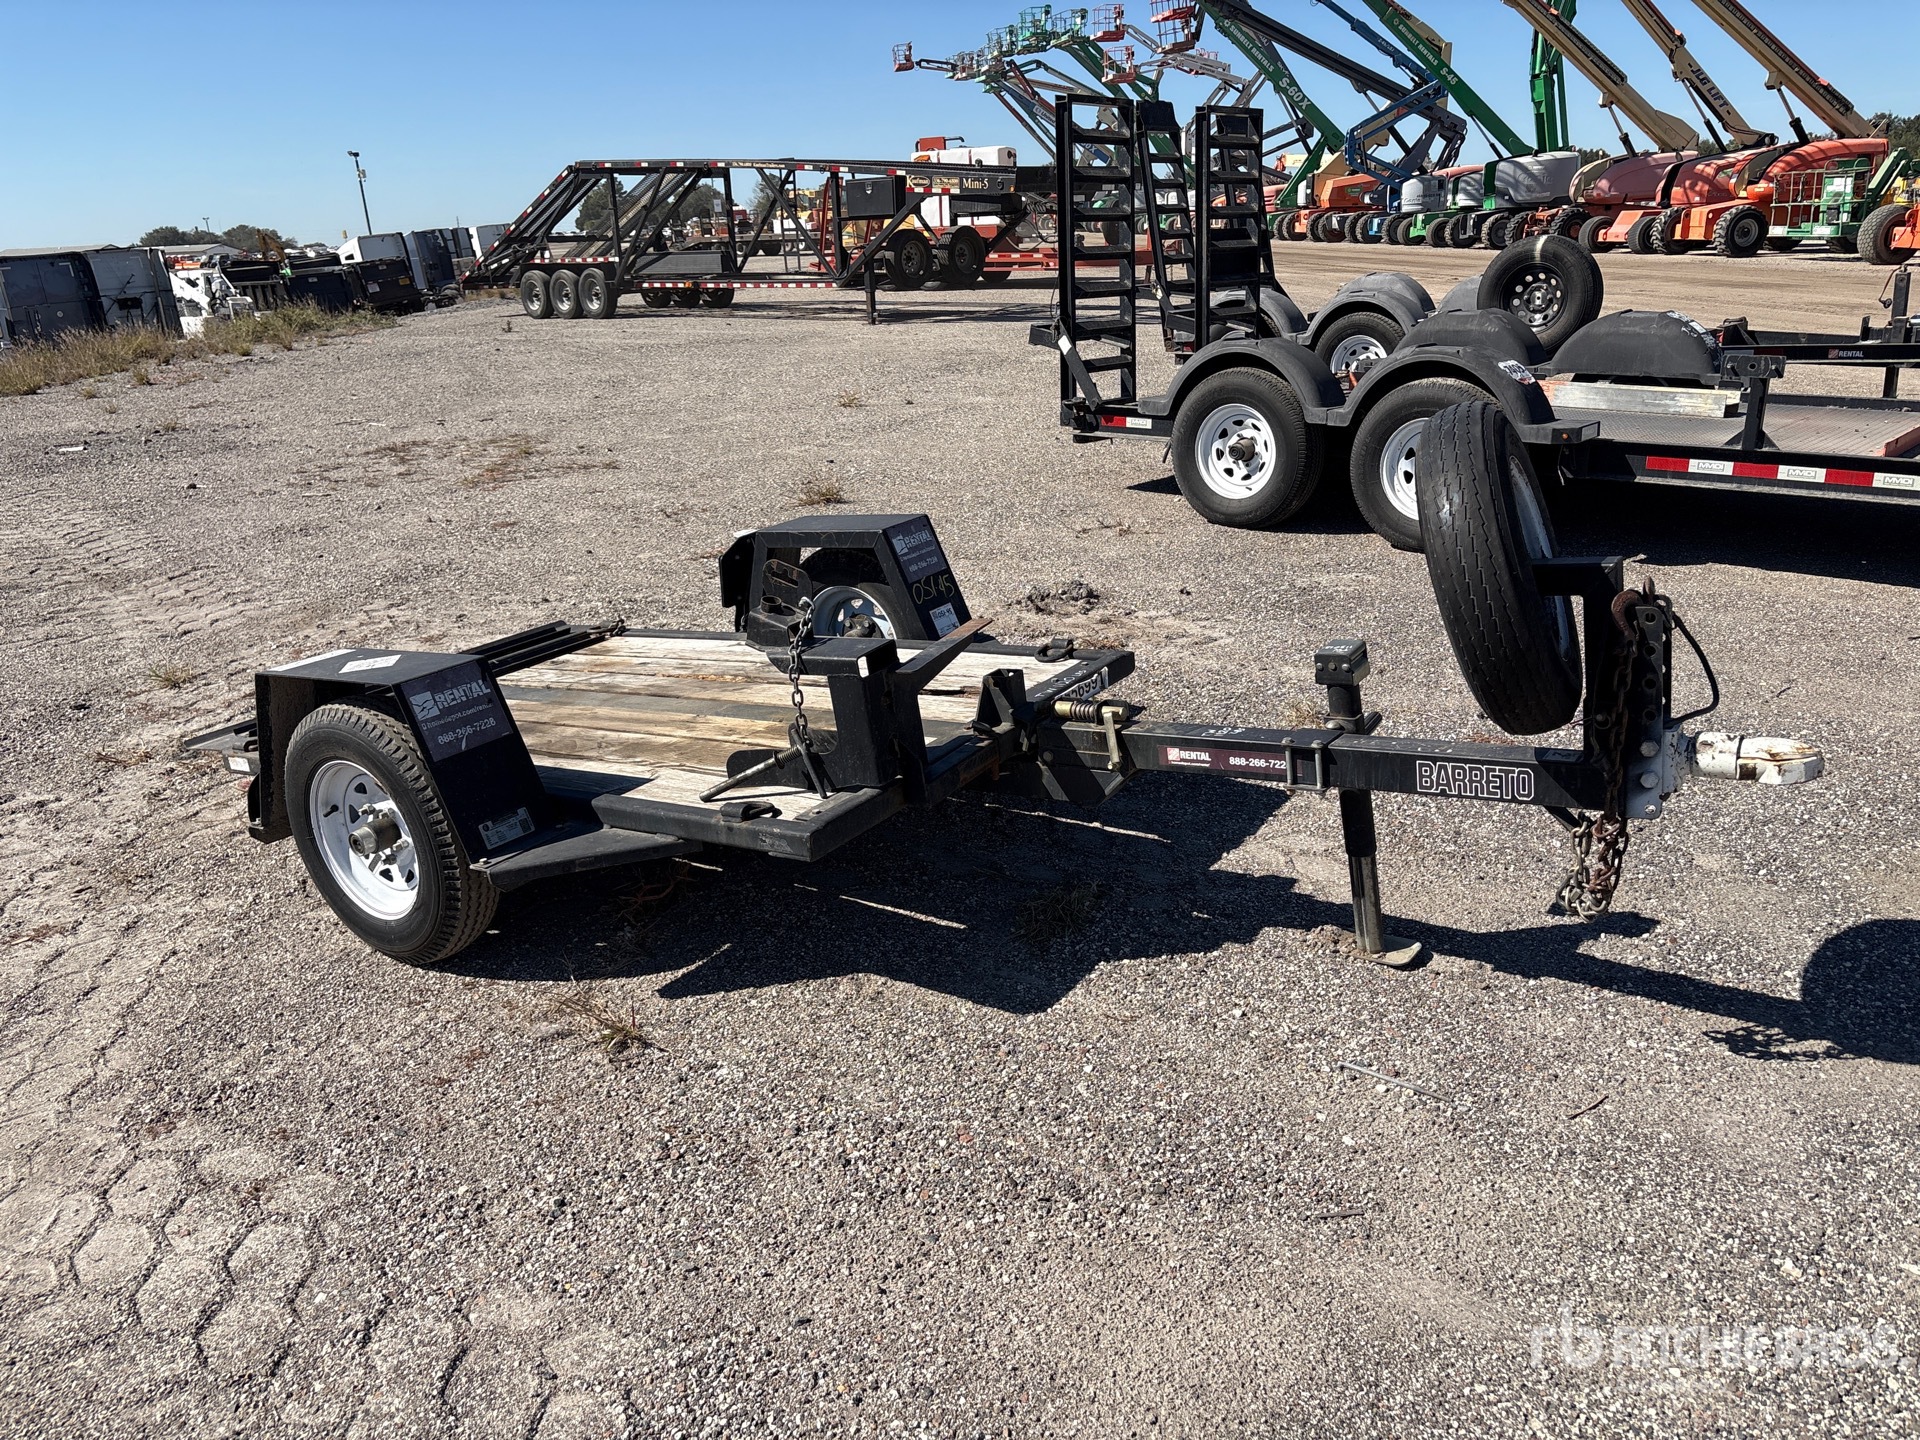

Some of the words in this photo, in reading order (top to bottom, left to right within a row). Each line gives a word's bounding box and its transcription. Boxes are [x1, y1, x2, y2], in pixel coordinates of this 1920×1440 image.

[1229, 24, 1252, 50] SUNBELT
[1251, 47, 1275, 73] RENTALS
[1398, 24, 1419, 46] SUNBELT
[1417, 43, 1438, 66] RENTALS
[1440, 67, 1458, 85] S-45
[1278, 77, 1312, 110] S-60X
[1690, 68, 1711, 87] JLG
[1706, 86, 1729, 108] LIFT
[962, 177, 989, 190] Mini-5
[1838, 350, 1865, 358] RENTAL
[904, 529, 934, 549] RENTAL
[434, 679, 491, 709] RENTAL
[437, 717, 496, 745] 888-266-7228
[1180, 751, 1212, 762] RENTAL
[1229, 756, 1286, 769] 888-266-722
[1416, 760, 1534, 800] BARRETO
